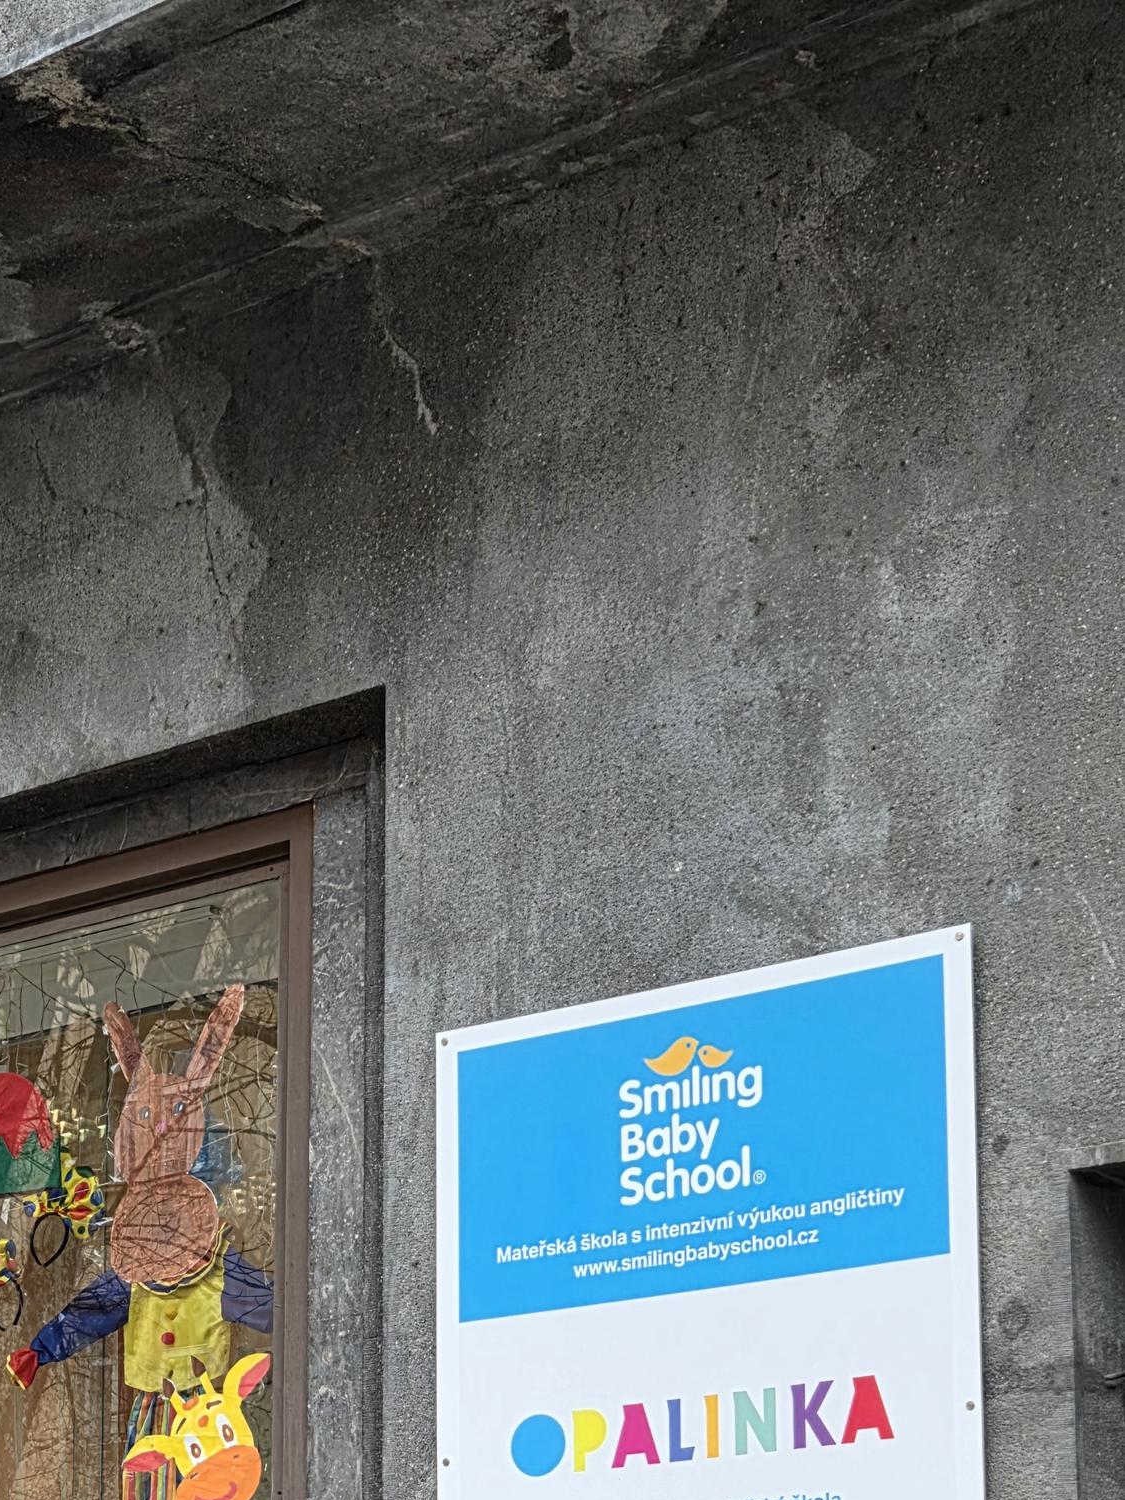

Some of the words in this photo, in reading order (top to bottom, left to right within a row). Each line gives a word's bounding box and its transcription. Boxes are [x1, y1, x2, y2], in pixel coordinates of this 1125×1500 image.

[619, 1065, 763, 1119] Smiling
[620, 1112, 720, 1162] Baby
[496, 1235, 577, 1264] Mateřská
[580, 1230, 628, 1252] škola
[631, 1230, 642, 1244] s
[645, 1208, 734, 1242] intenzivní
[736, 1204, 806, 1230] výukou
[809, 1186, 905, 1216] angličtiny
[573, 1229, 819, 1278] www.smilingbabyschool.cz
[510, 1374, 895, 1478] OPALINKA
